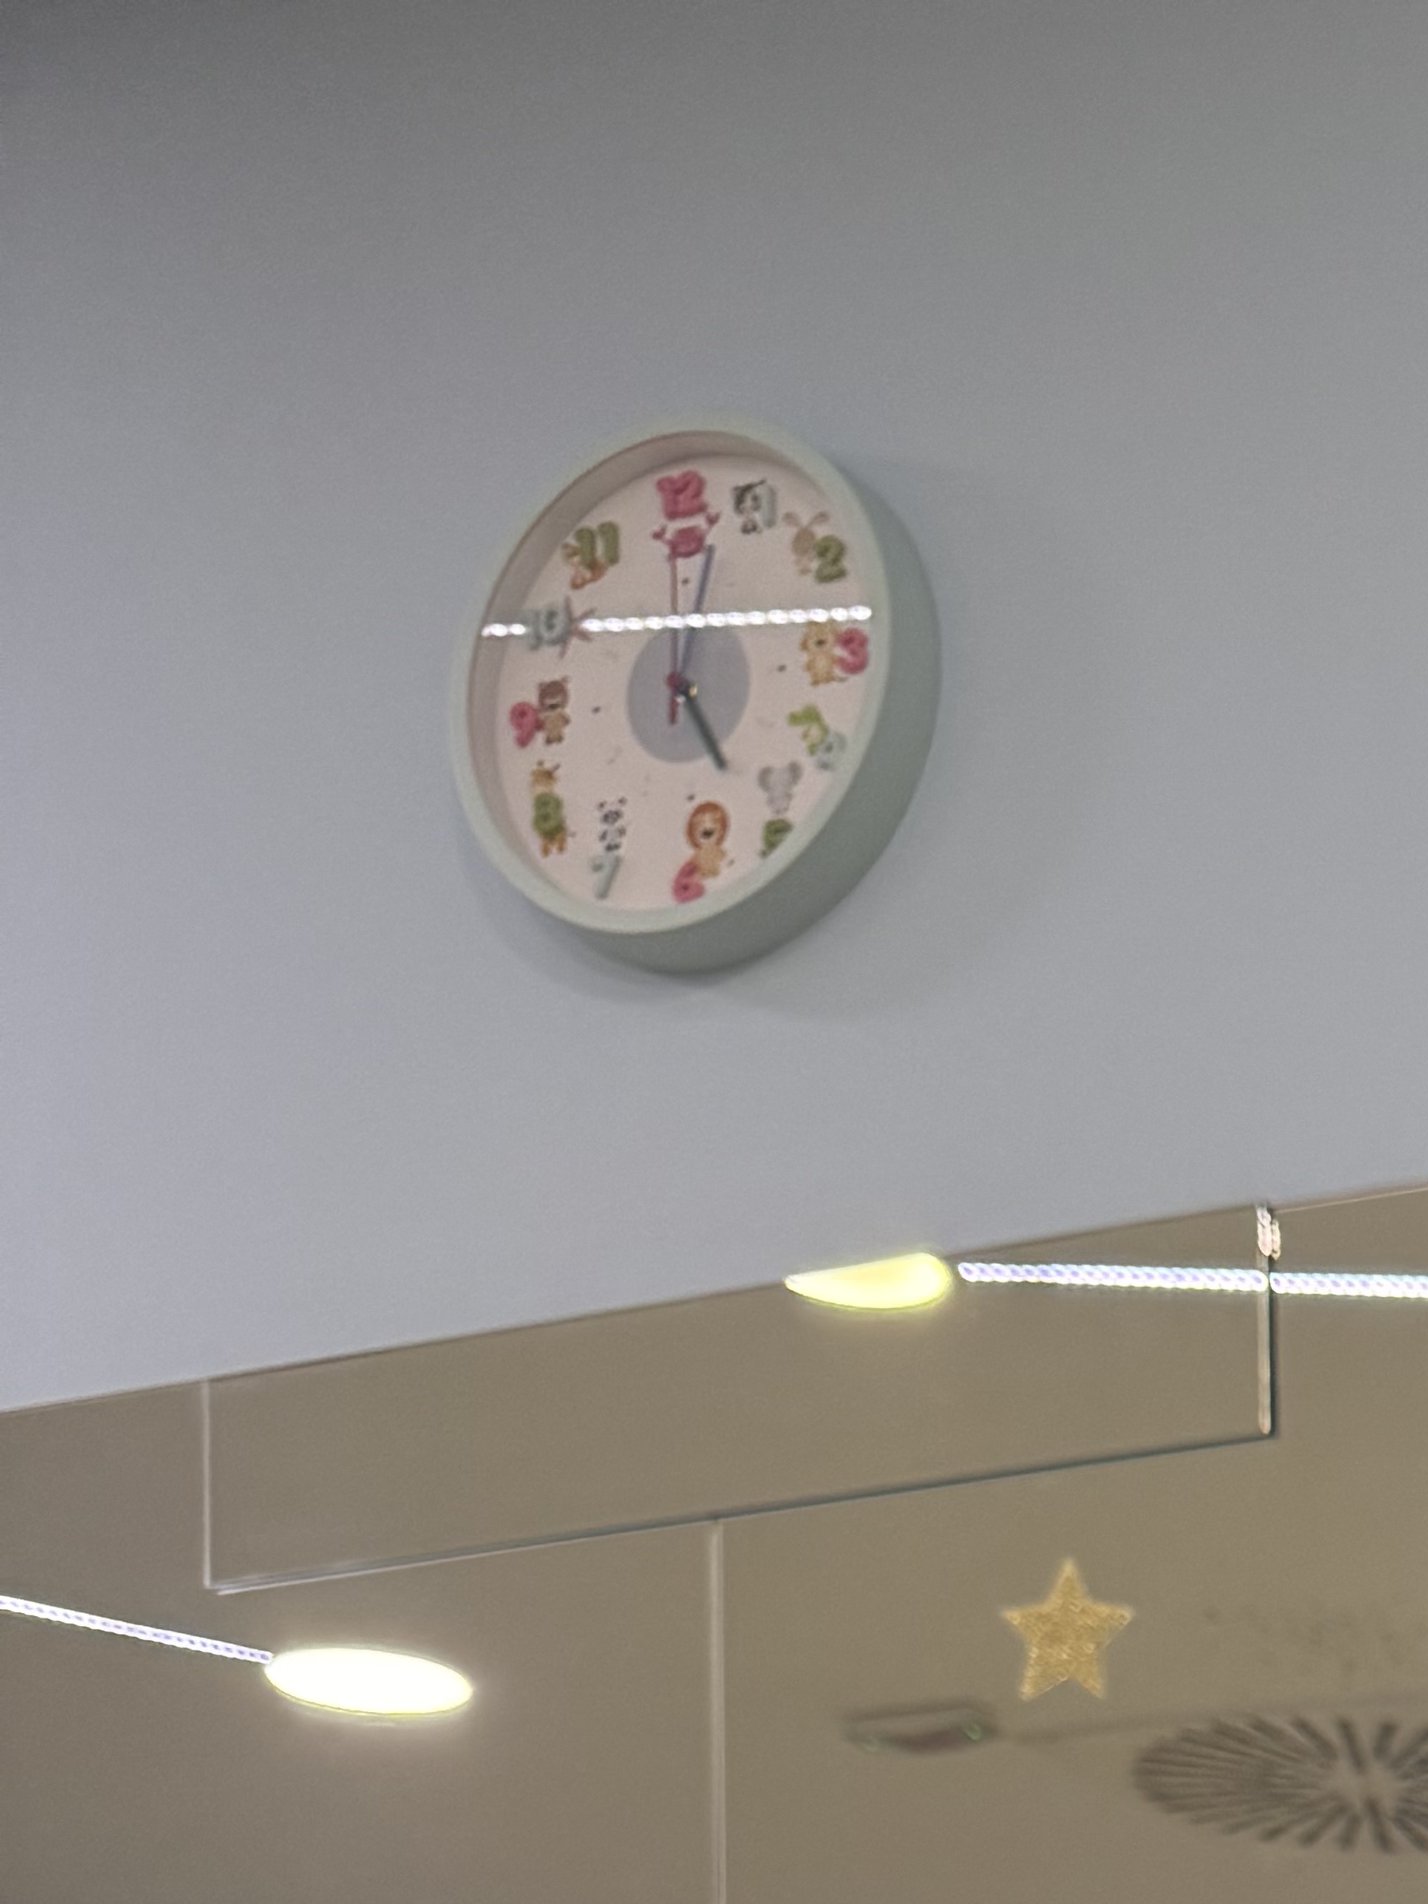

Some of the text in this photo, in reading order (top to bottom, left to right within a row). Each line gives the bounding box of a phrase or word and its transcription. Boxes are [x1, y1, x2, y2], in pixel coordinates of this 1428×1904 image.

[655, 470, 706, 521] 12
[575, 521, 620, 569] 11
[814, 534, 847, 583] 2
[837, 627, 869, 675] 3
[510, 702, 539, 748] 9
[673, 860, 705, 903] 6
